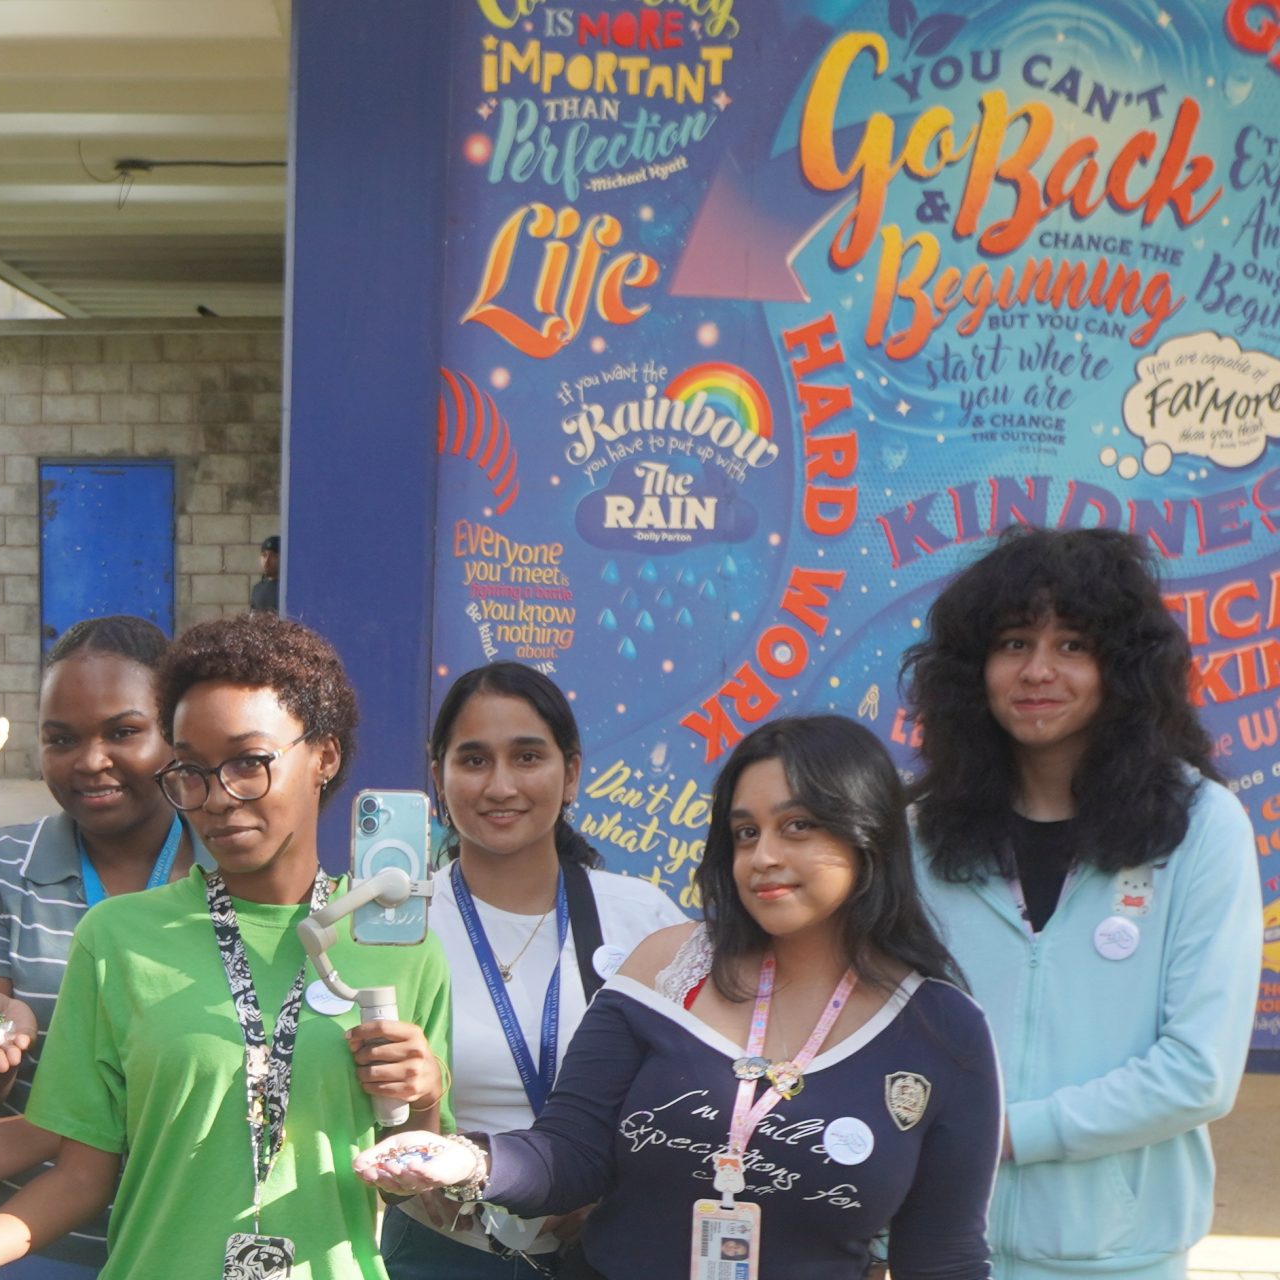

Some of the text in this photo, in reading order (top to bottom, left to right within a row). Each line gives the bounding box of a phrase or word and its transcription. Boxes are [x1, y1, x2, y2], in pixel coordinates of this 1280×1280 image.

[544, 9, 574, 37] IS
[578, 9, 683, 50] MORE
[891, 49, 1168, 122] YOU CAN'T
[544, 98, 621, 122] THAN
[487, 97, 717, 201] Perfection
[799, 31, 1223, 269] Go Back
[916, 190, 951, 225] &
[1039, 231, 1184, 268] CHANGE THE
[460, 202, 660, 359] Life
[864, 224, 1186, 360] Beginning
[988, 313, 1126, 340] BUT YOU CAN
[926, 333, 1114, 391] start where
[575, 376, 600, 402] you
[602, 363, 638, 384] want
[642, 360, 668, 383] the
[958, 375, 1077, 428] you are
[561, 383, 779, 468] Rainbow
[781, 312, 860, 538] HARD
[972, 431, 1066, 446] THE OUTCOME
[991, 414, 1066, 432] CHANGE
[584, 435, 747, 486] you have to put up with
[635, 461, 694, 496] The
[603, 496, 718, 530] RAIN
[452, 518, 565, 569] Everyone
[661, 531, 692, 543] Parton
[463, 561, 500, 586] you
[510, 563, 560, 586] meet
[464, 602, 482, 623] Be
[481, 599, 576, 625] You know
[496, 622, 575, 649] nothing
[678, 564, 847, 765] WORK
[585, 759, 672, 816] Don't
[580, 812, 669, 853] what
[488, 985, 501, 1003] WEST
[495, 1002, 506, 1018] THE
[501, 1017, 510, 1028] OF
[505, 1028, 526, 1070] UNIVERSITY
[520, 1070, 531, 1084] THE
[803, 1183, 861, 1210] for
